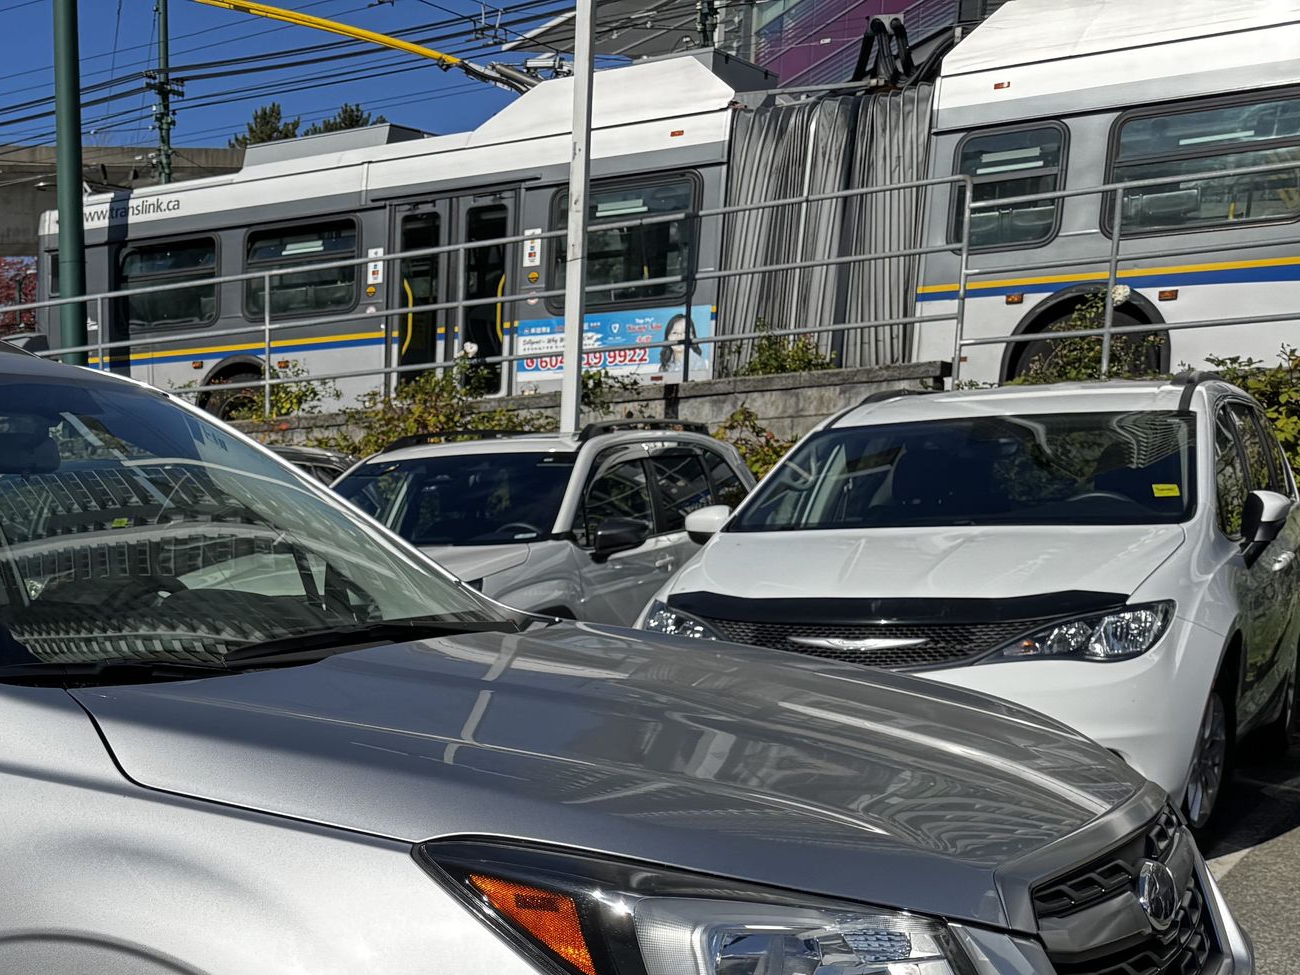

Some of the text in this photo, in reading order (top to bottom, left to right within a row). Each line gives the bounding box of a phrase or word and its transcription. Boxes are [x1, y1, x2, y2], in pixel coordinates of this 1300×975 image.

[84, 198, 181, 222] ww.translink.ca
[582, 350, 603, 367] 19
[607, 347, 649, 365] 9922
